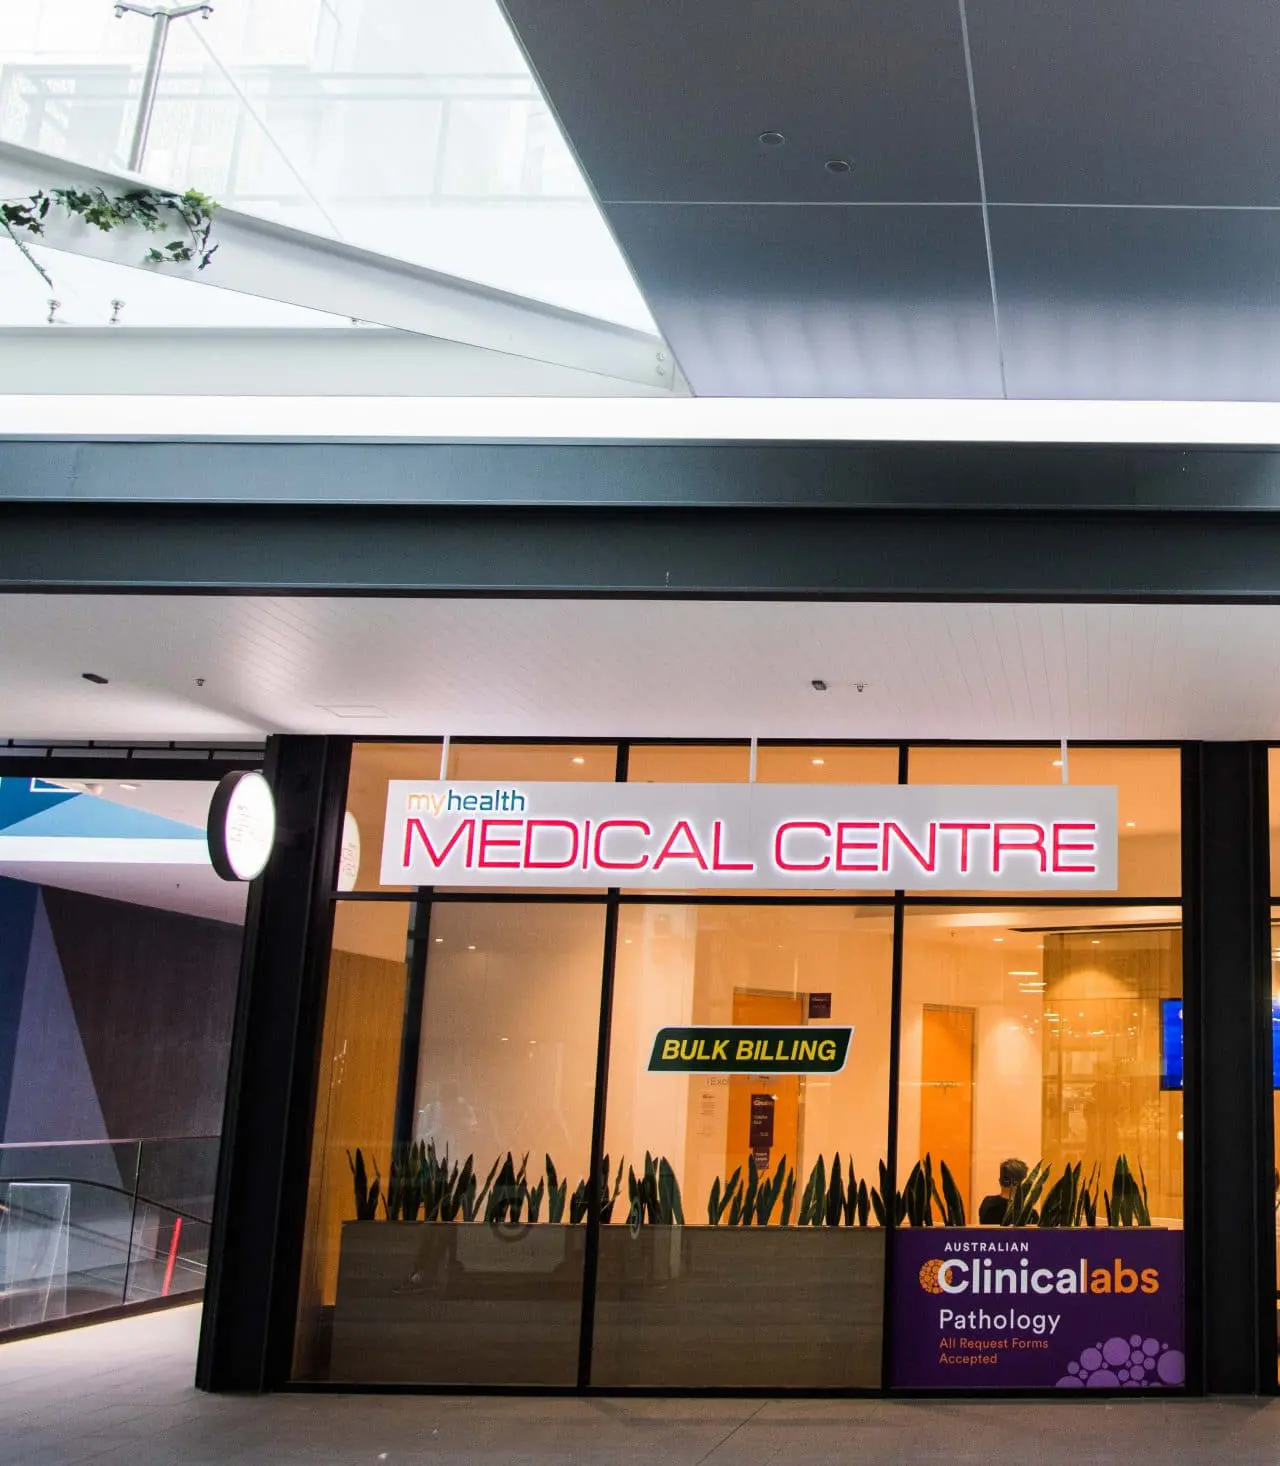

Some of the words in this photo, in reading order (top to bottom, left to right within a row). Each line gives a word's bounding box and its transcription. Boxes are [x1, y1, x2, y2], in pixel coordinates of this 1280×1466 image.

[406, 789, 525, 817] myhealth
[402, 818, 754, 871] MEDICAL
[774, 821, 1096, 873] CENTRE
[661, 1039, 730, 1061] BULK
[735, 1039, 837, 1061] BILLING
[944, 1242, 1029, 1252] AUSTRALIAN
[937, 1258, 1160, 1295] Clinicalabs
[939, 1309, 1061, 1334] Pathology
[939, 1338, 954, 1349] All
[959, 1338, 1008, 1352] Request
[1012, 1338, 1049, 1349] Forms
[939, 1353, 998, 1365] Accepted
